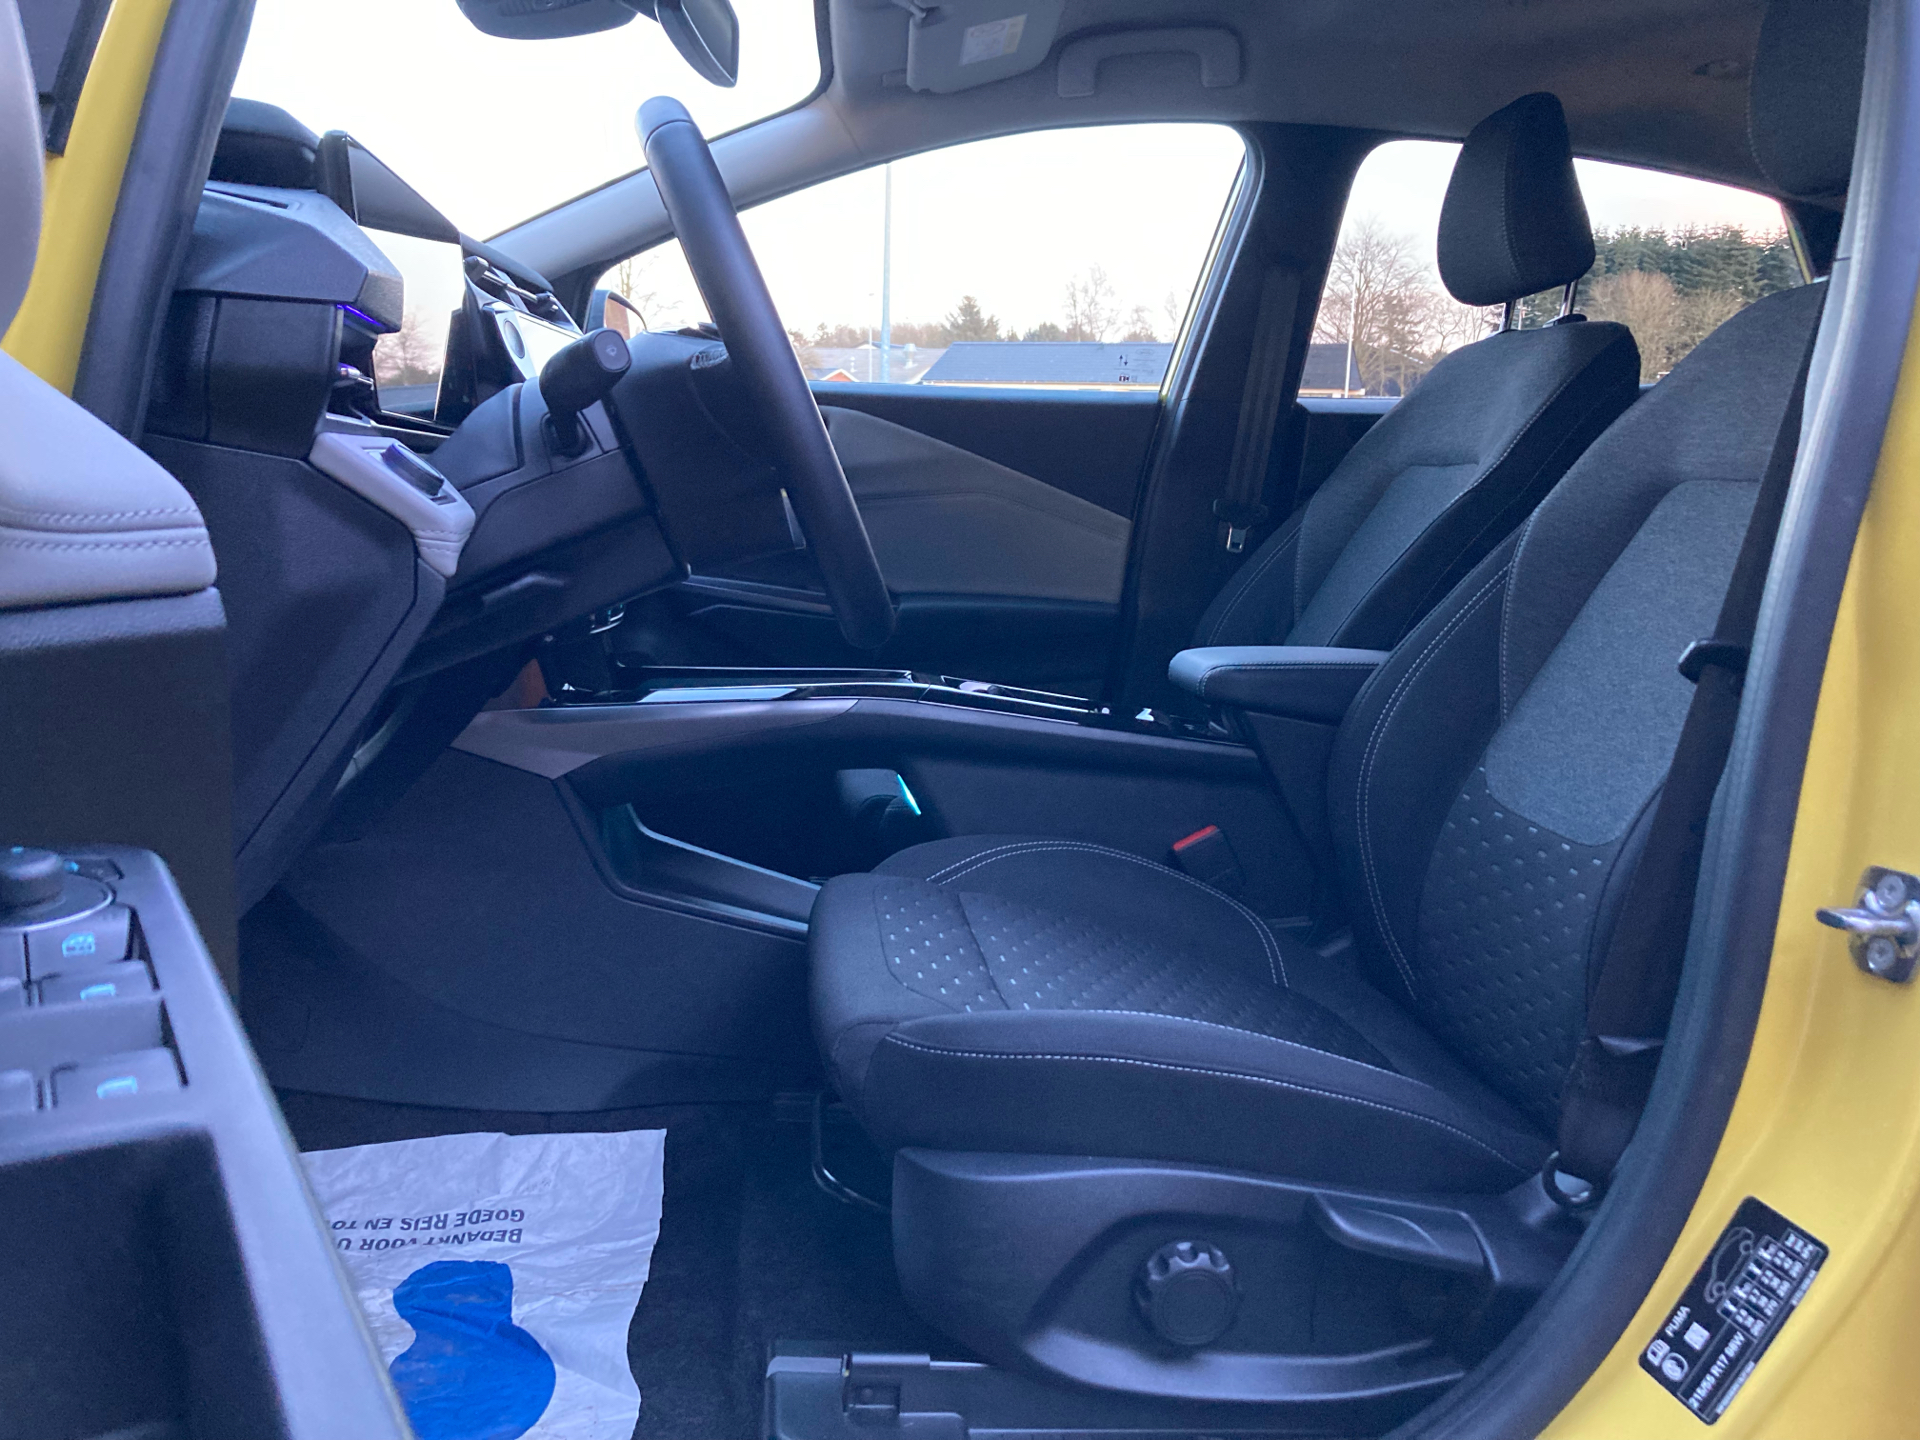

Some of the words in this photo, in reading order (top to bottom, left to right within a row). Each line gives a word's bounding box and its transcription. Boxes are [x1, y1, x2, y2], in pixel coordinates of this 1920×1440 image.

[327, 1220, 357, 1231] TO
[364, 1218, 394, 1230] EN
[400, 1213, 449, 1231] REIS
[453, 1209, 525, 1228] GOEDE
[359, 1238, 417, 1250] VOOR
[423, 1228, 523, 1245] BEDANKT
[1665, 1305, 1691, 1337] PUMA
[1710, 1353, 1729, 1378] R17
